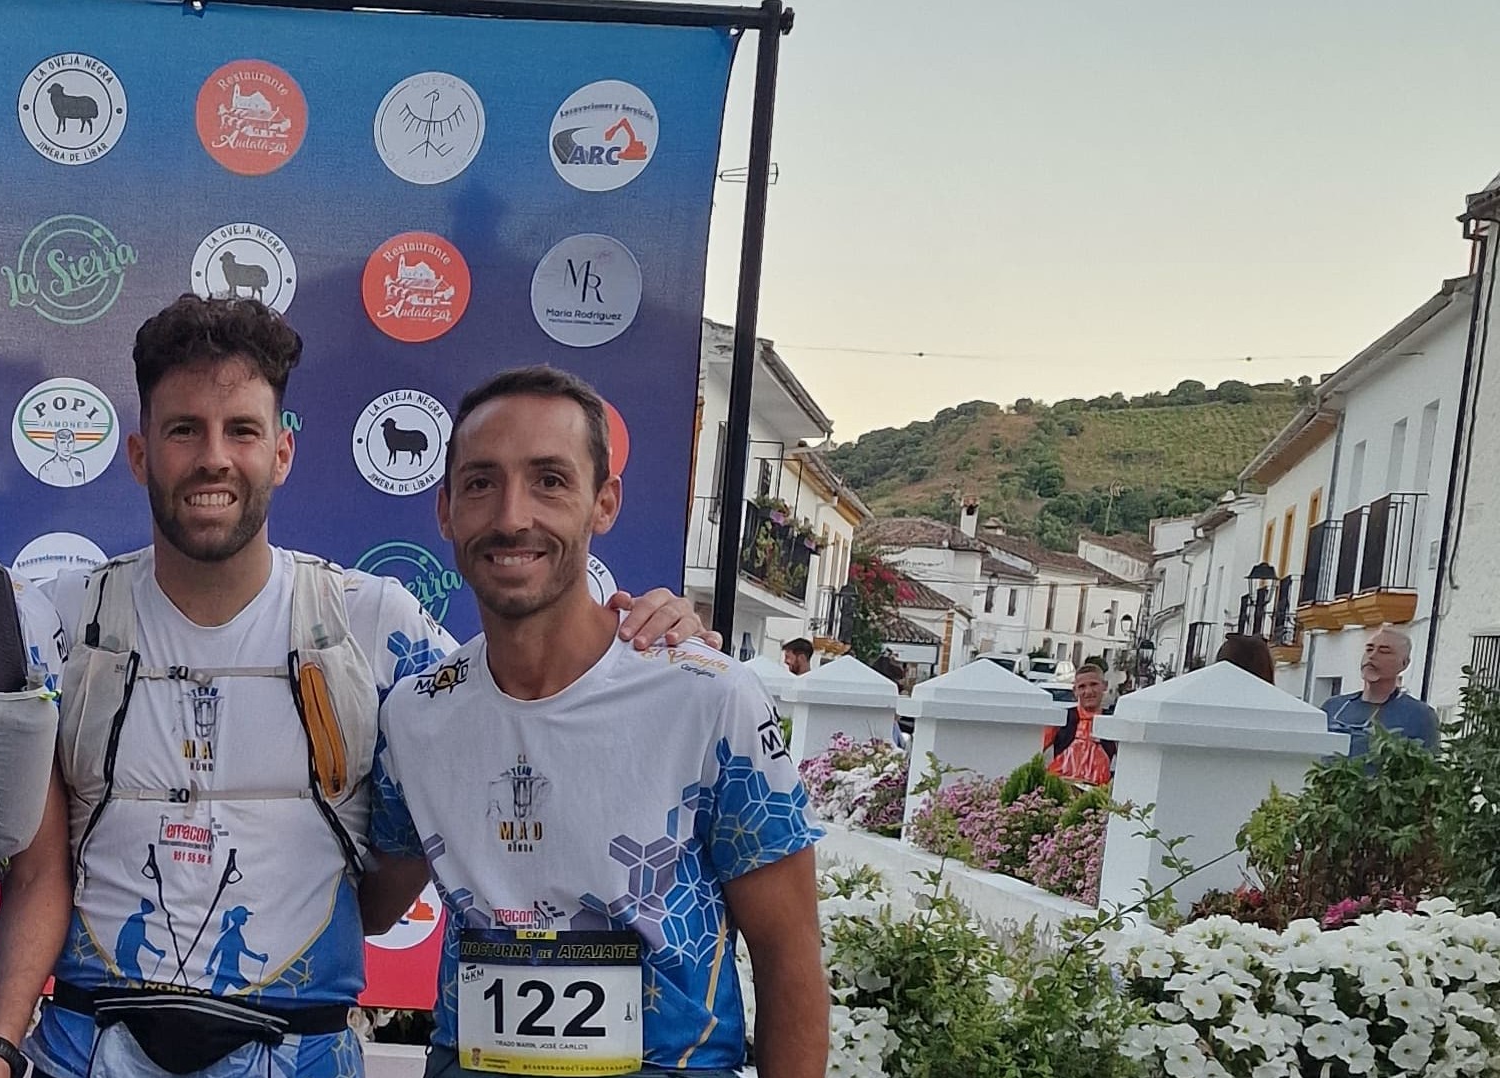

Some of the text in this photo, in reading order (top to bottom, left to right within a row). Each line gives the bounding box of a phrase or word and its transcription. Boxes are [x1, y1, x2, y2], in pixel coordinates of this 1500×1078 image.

[33, 56, 115, 85] LA OVEJA NEGRA
[218, 70, 290, 96] Restaurante
[36, 140, 67, 160] JIMERA
[69, 152, 81, 162] DE
[568, 145, 621, 166] ARC
[205, 226, 284, 255] LA OVEJA NEGRA
[382, 243, 451, 265] Restaurante
[47, 240, 139, 296] Sierra
[33, 397, 100, 419] POPI
[367, 392, 445, 419] LA OVEJA NEGRA
[367, 474, 396, 492] JIMERA
[398, 483, 410, 492] DE
[182, 740, 213, 759] MA
[511, 766, 532, 776] TEAM
[500, 821, 542, 840] MAD
[557, 944, 637, 958] ATAJATE
[484, 978, 606, 1037] 122
